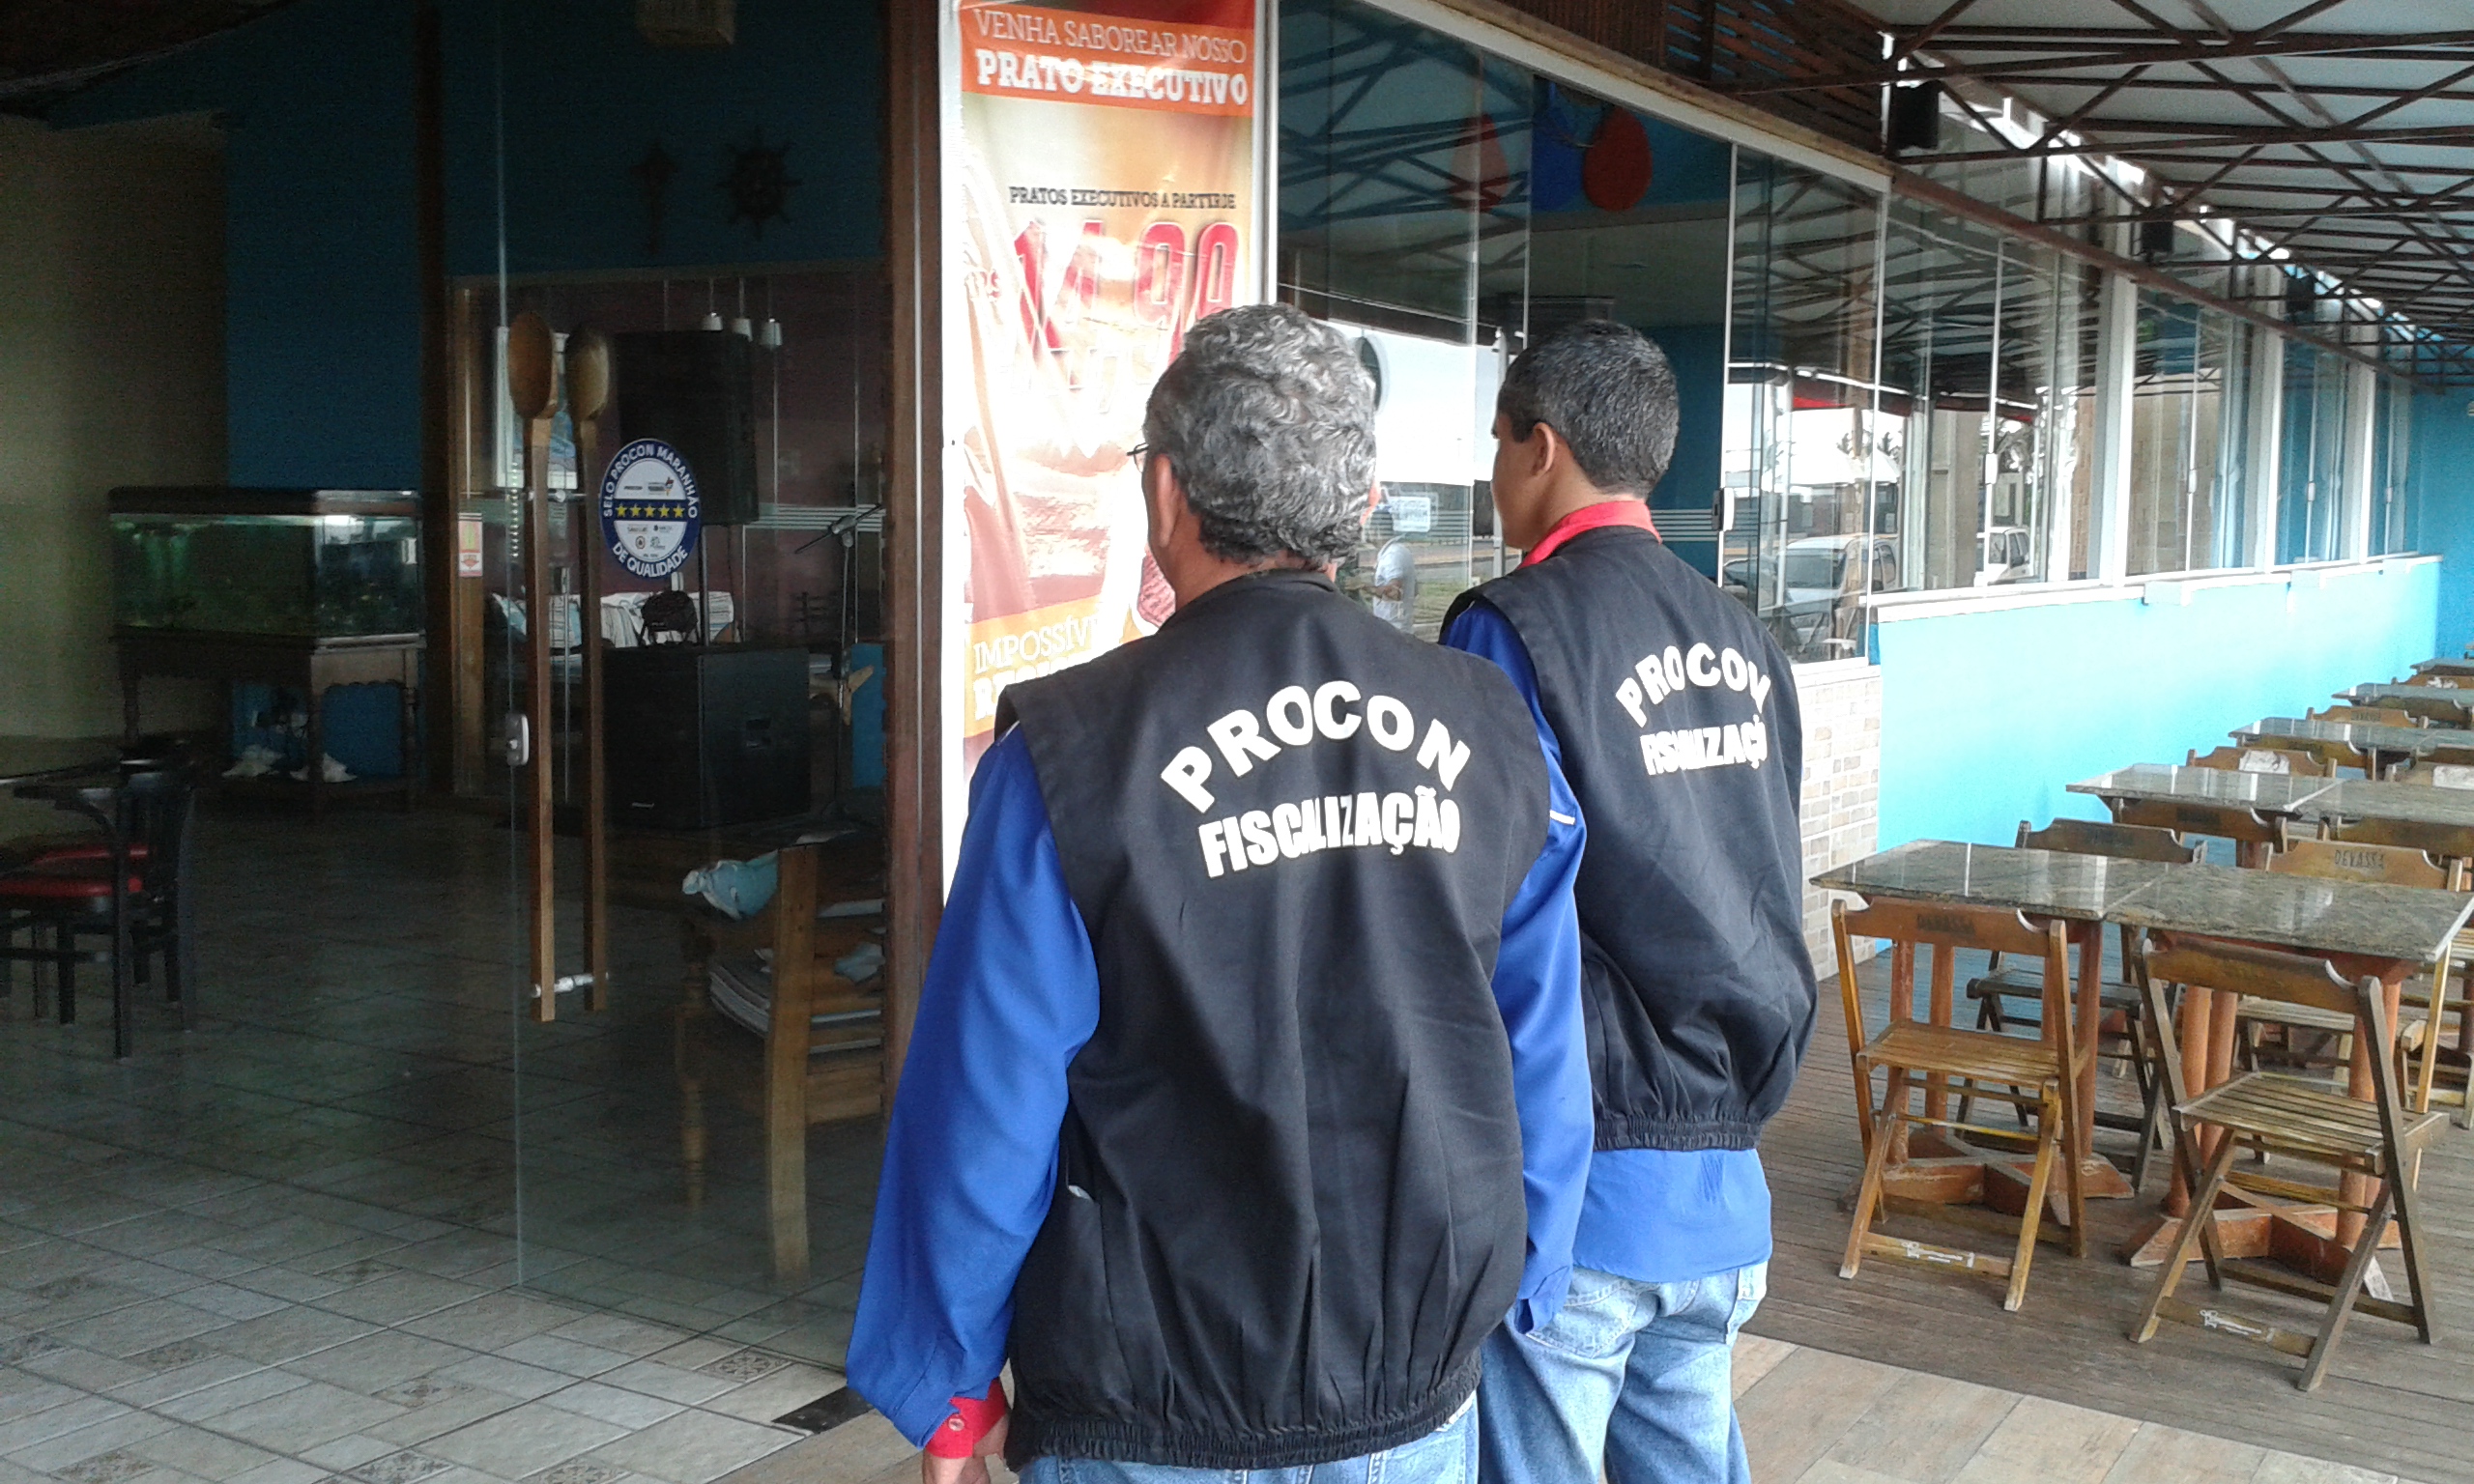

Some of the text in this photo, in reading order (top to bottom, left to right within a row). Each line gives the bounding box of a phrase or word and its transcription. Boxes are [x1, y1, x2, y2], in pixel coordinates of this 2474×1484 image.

[974, 9, 1247, 64] VENHA SABOREAR NOSSO
[976, 48, 1249, 105] PRATO EXECUTIVO
[1009, 186, 1067, 205] PRATOS
[1070, 188, 1159, 208] EXECUTIVOS
[1160, 192, 1170, 208] A
[603, 482, 616, 517] SELO
[611, 443, 654, 479] PROCON
[613, 542, 688, 577] DE QUALIDADE
[1161, 680, 1471, 813] PROCON
[1198, 785, 1460, 878] FISCALIZAÇÃO
